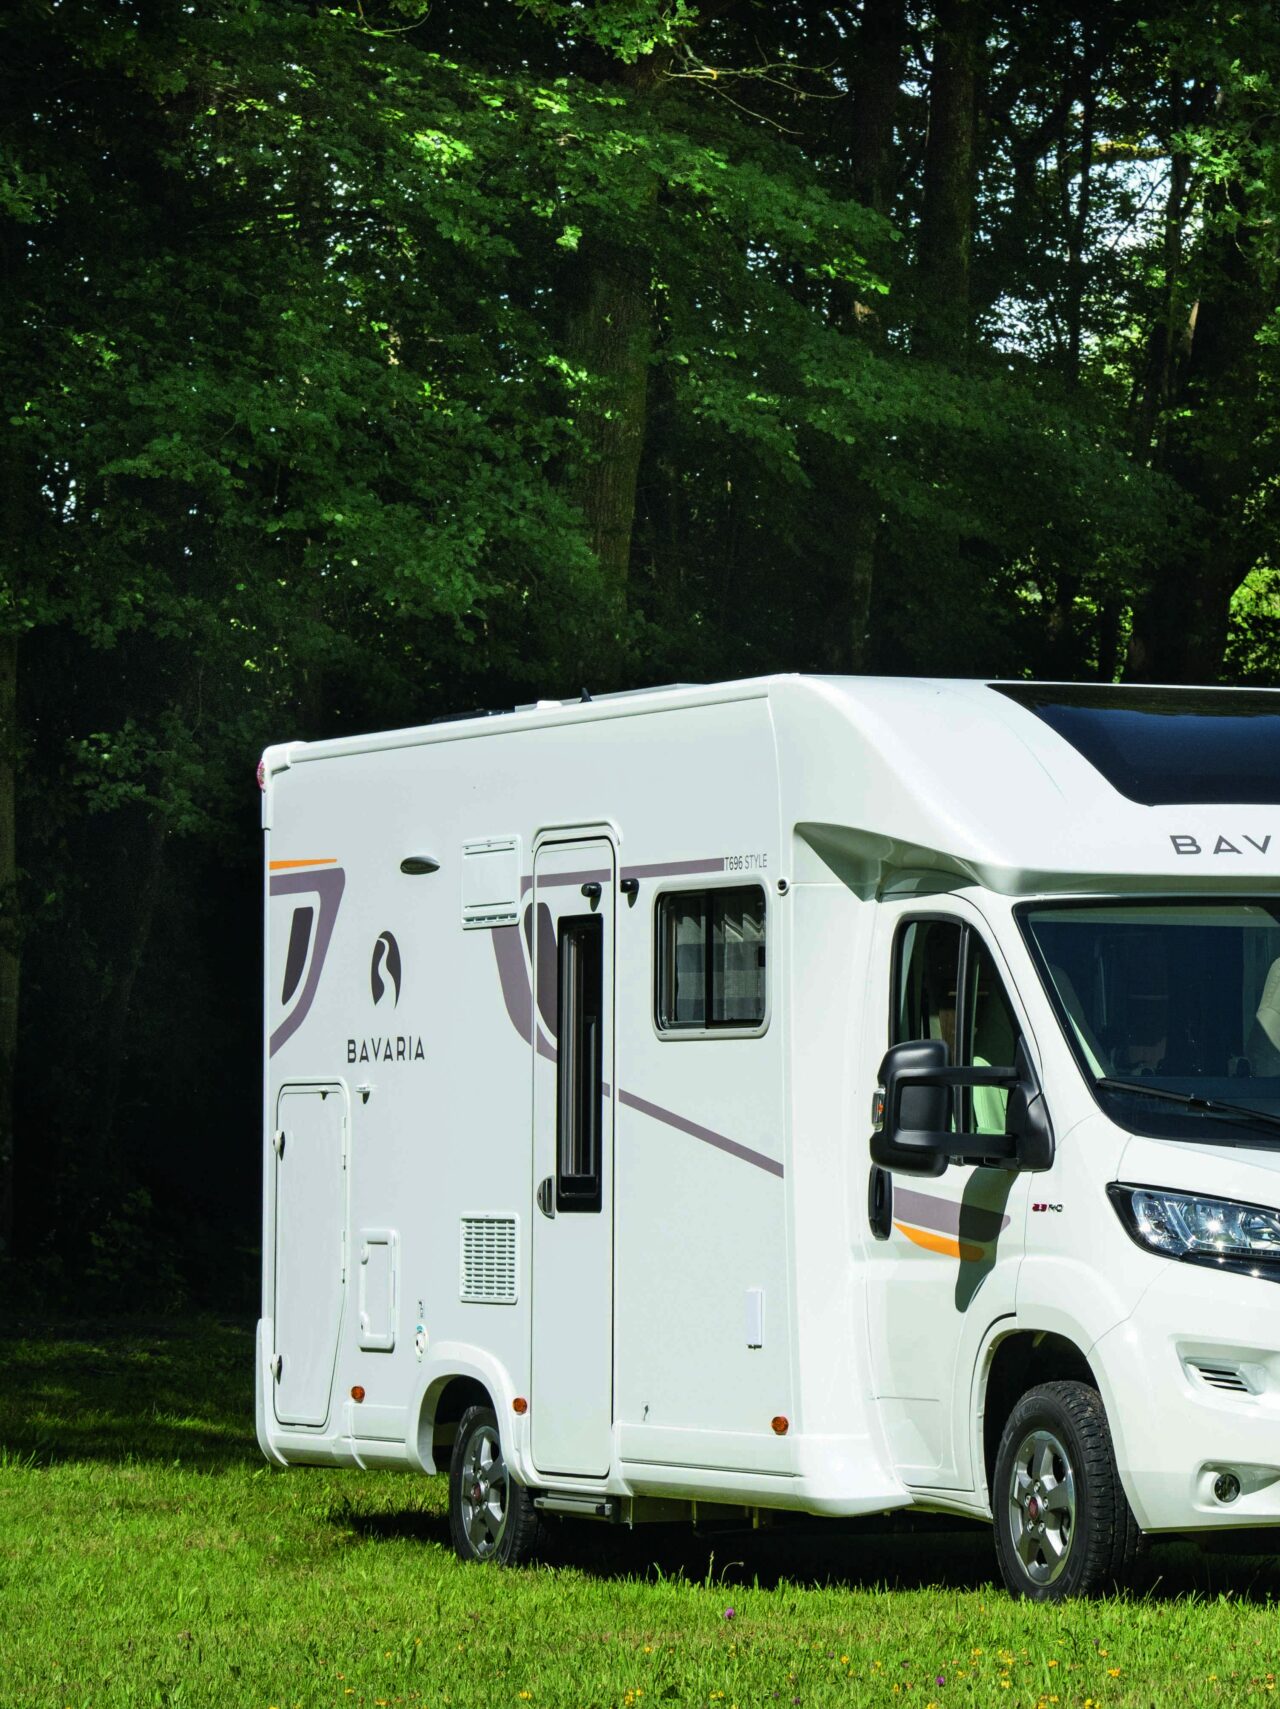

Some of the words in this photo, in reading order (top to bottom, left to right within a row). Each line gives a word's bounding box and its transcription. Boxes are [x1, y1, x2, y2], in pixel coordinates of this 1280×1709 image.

[724, 856, 743, 871] T696
[744, 853, 768, 870] STYLE
[347, 1035, 425, 1063] BAVARIA
